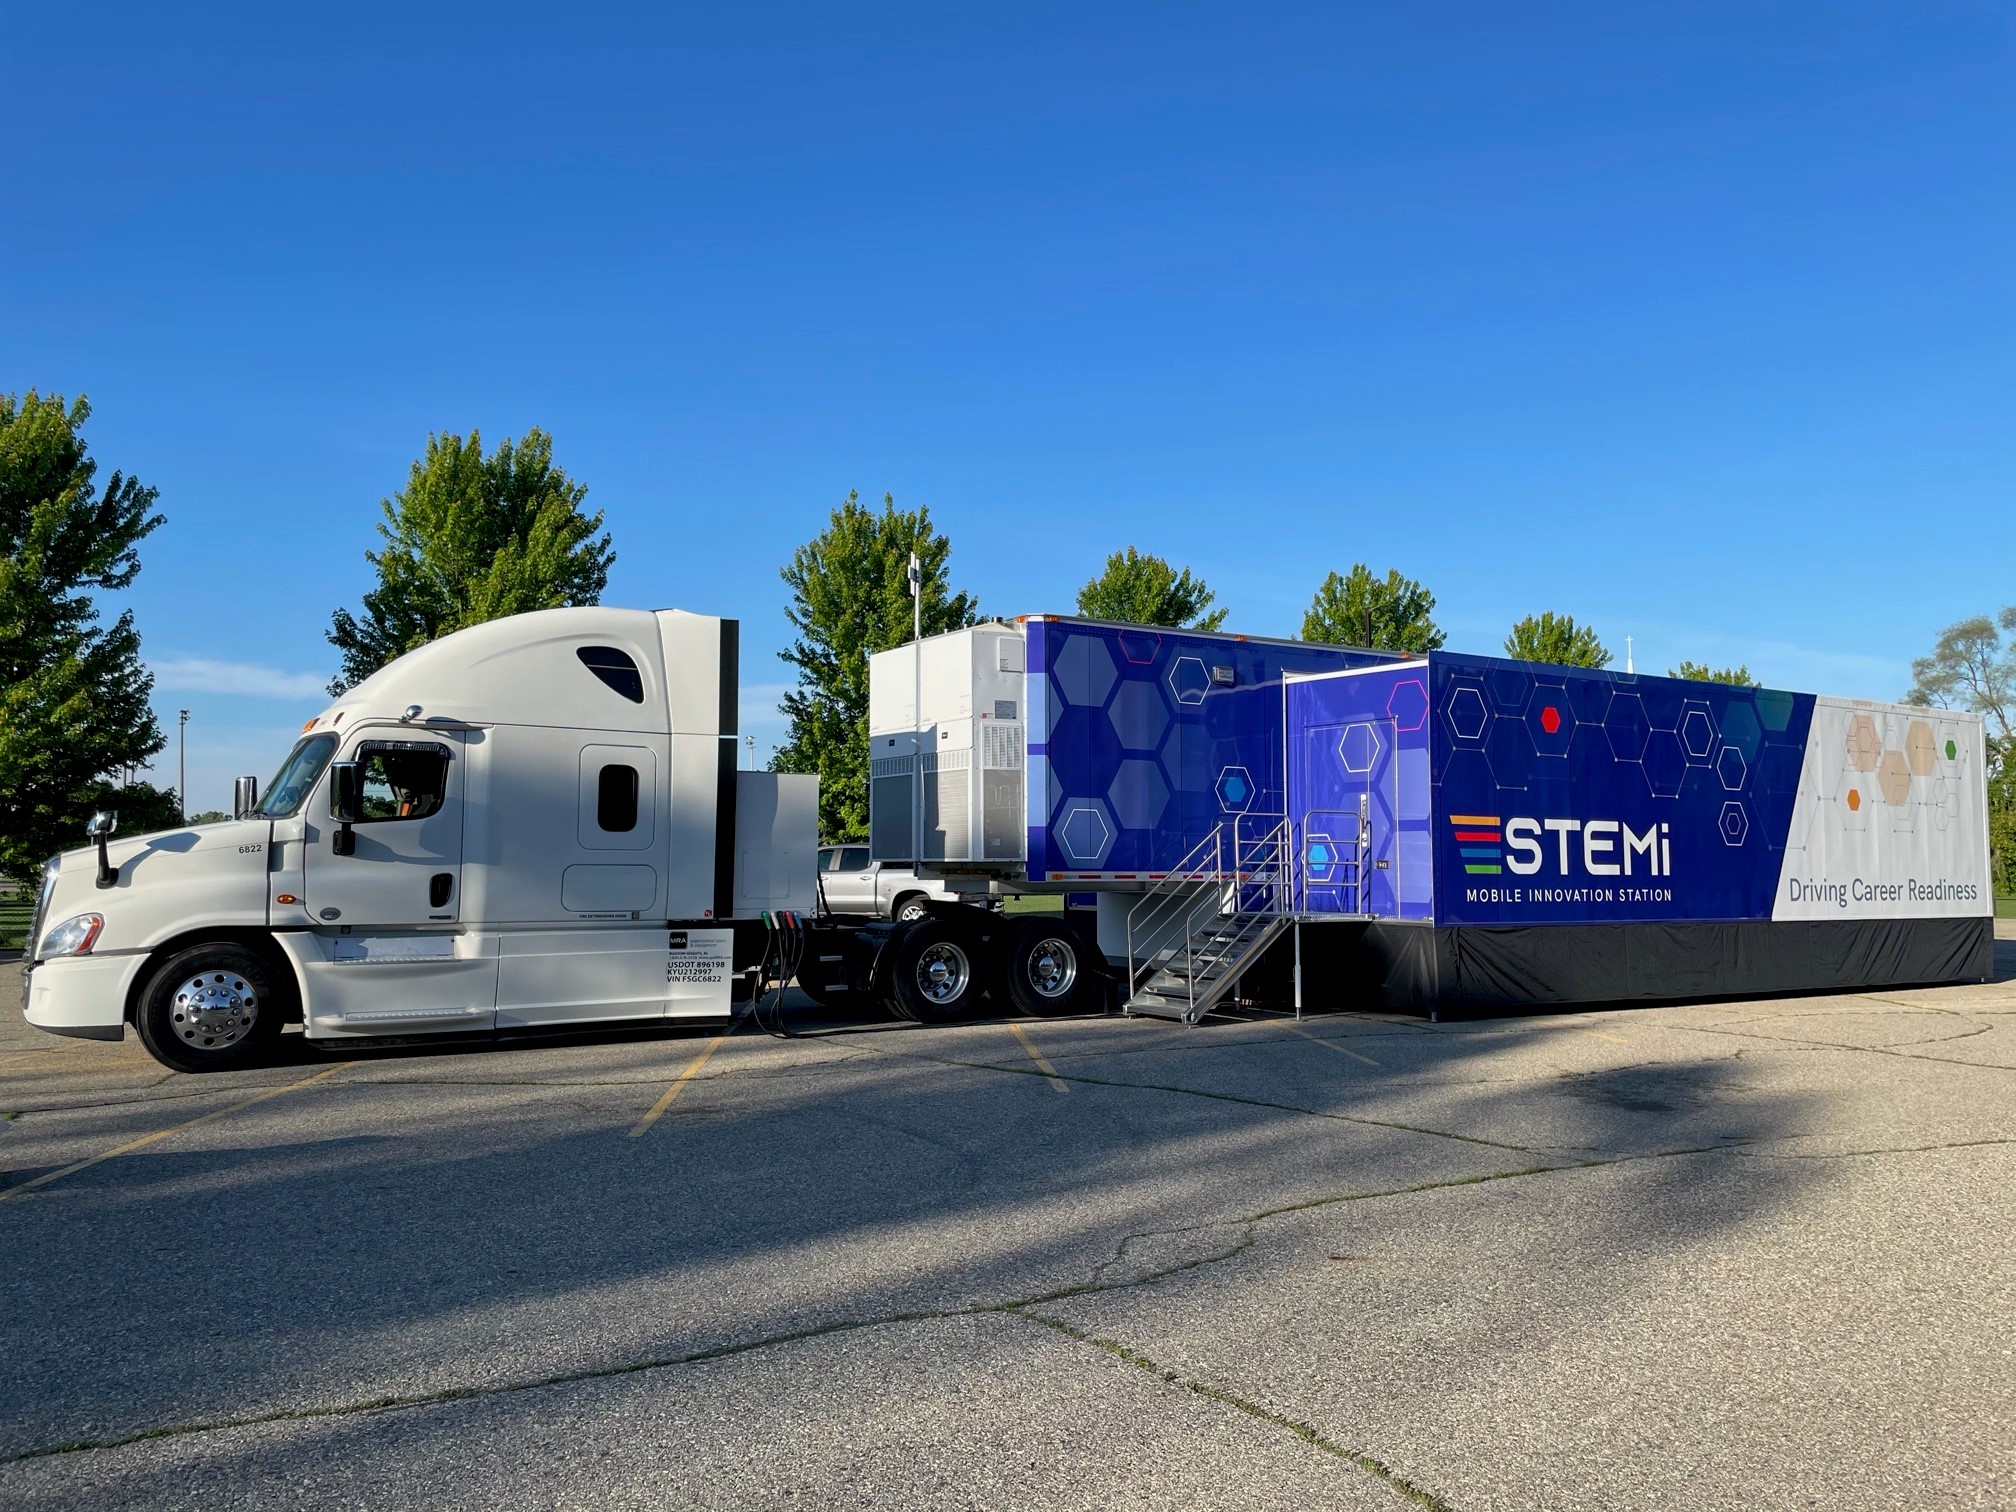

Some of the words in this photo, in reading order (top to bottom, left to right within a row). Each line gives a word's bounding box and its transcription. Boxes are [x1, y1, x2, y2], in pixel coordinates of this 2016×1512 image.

[238, 844, 262, 854] 6822
[1466, 888, 1522, 902] MOBILE
[1529, 888, 1614, 902] INNOVATION
[1619, 888, 1672, 902] STATION
[1789, 877, 1848, 908] Driving
[1851, 877, 1904, 902] Career
[1908, 878, 1978, 901] Readiness
